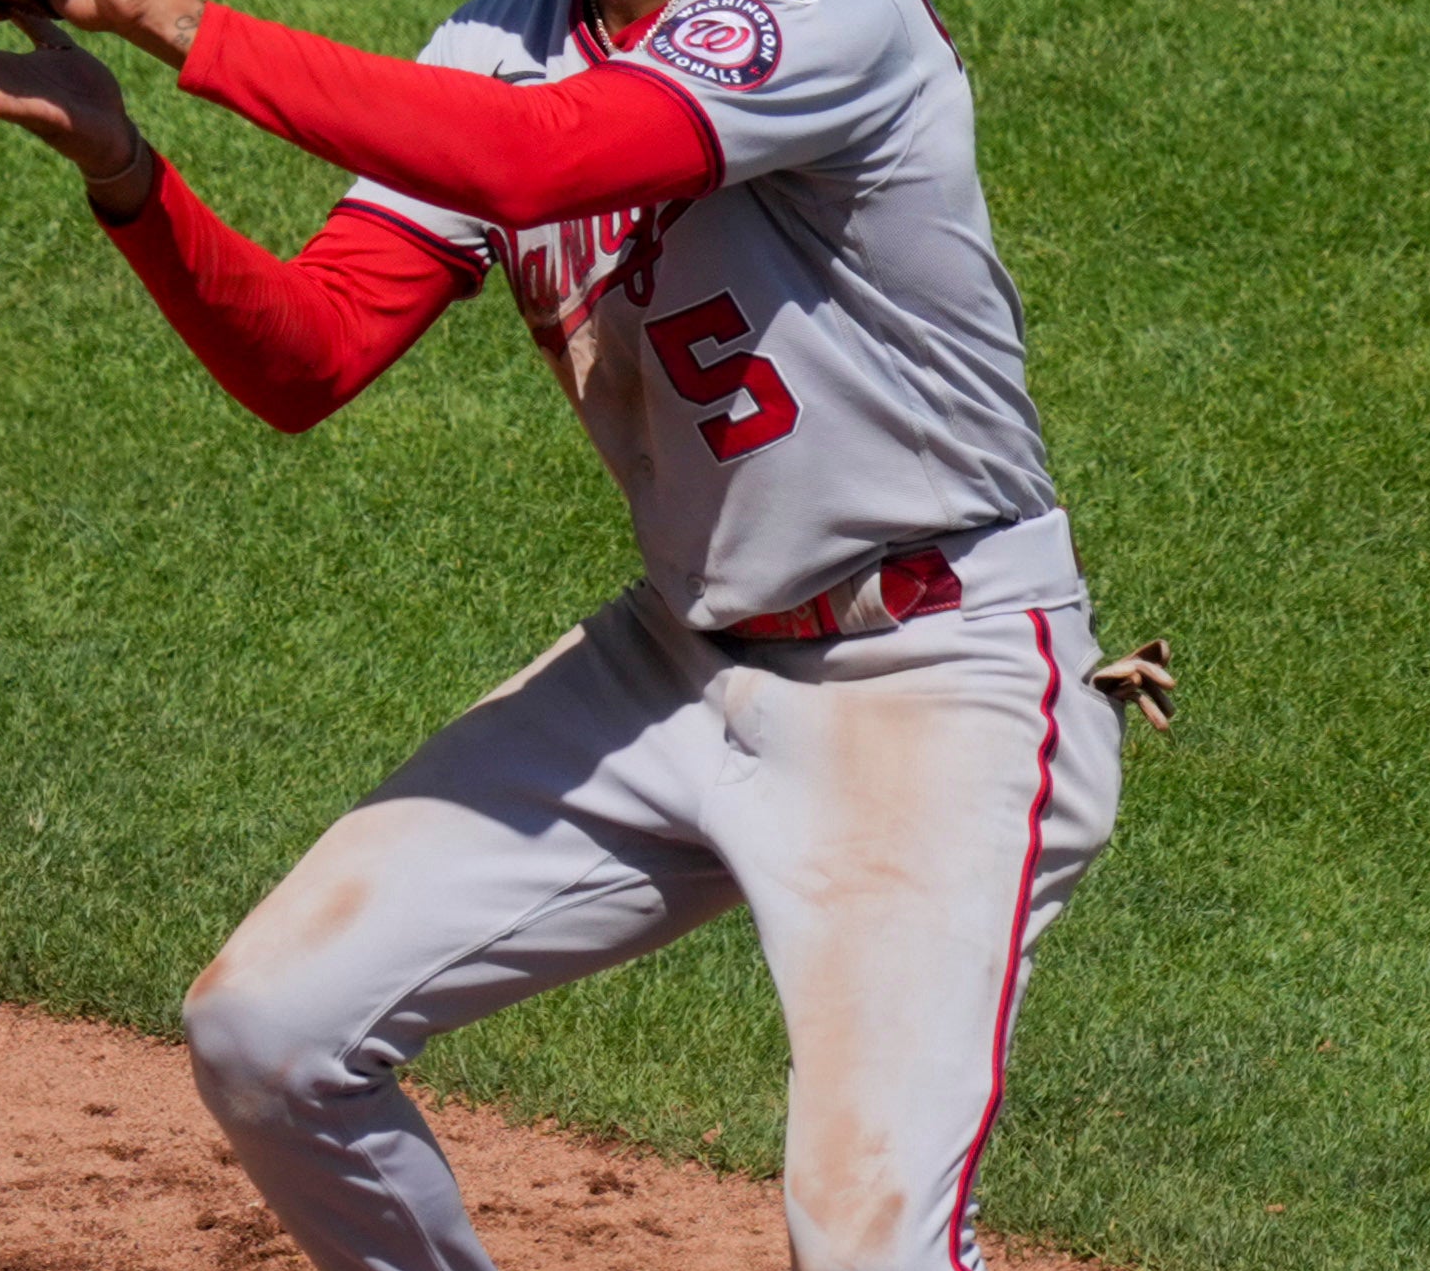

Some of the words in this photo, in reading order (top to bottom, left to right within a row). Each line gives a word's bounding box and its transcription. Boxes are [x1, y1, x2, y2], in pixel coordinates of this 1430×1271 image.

[653, 35, 742, 84] NATIONALS
[683, 19, 750, 53] W
[644, 287, 804, 464] 5
